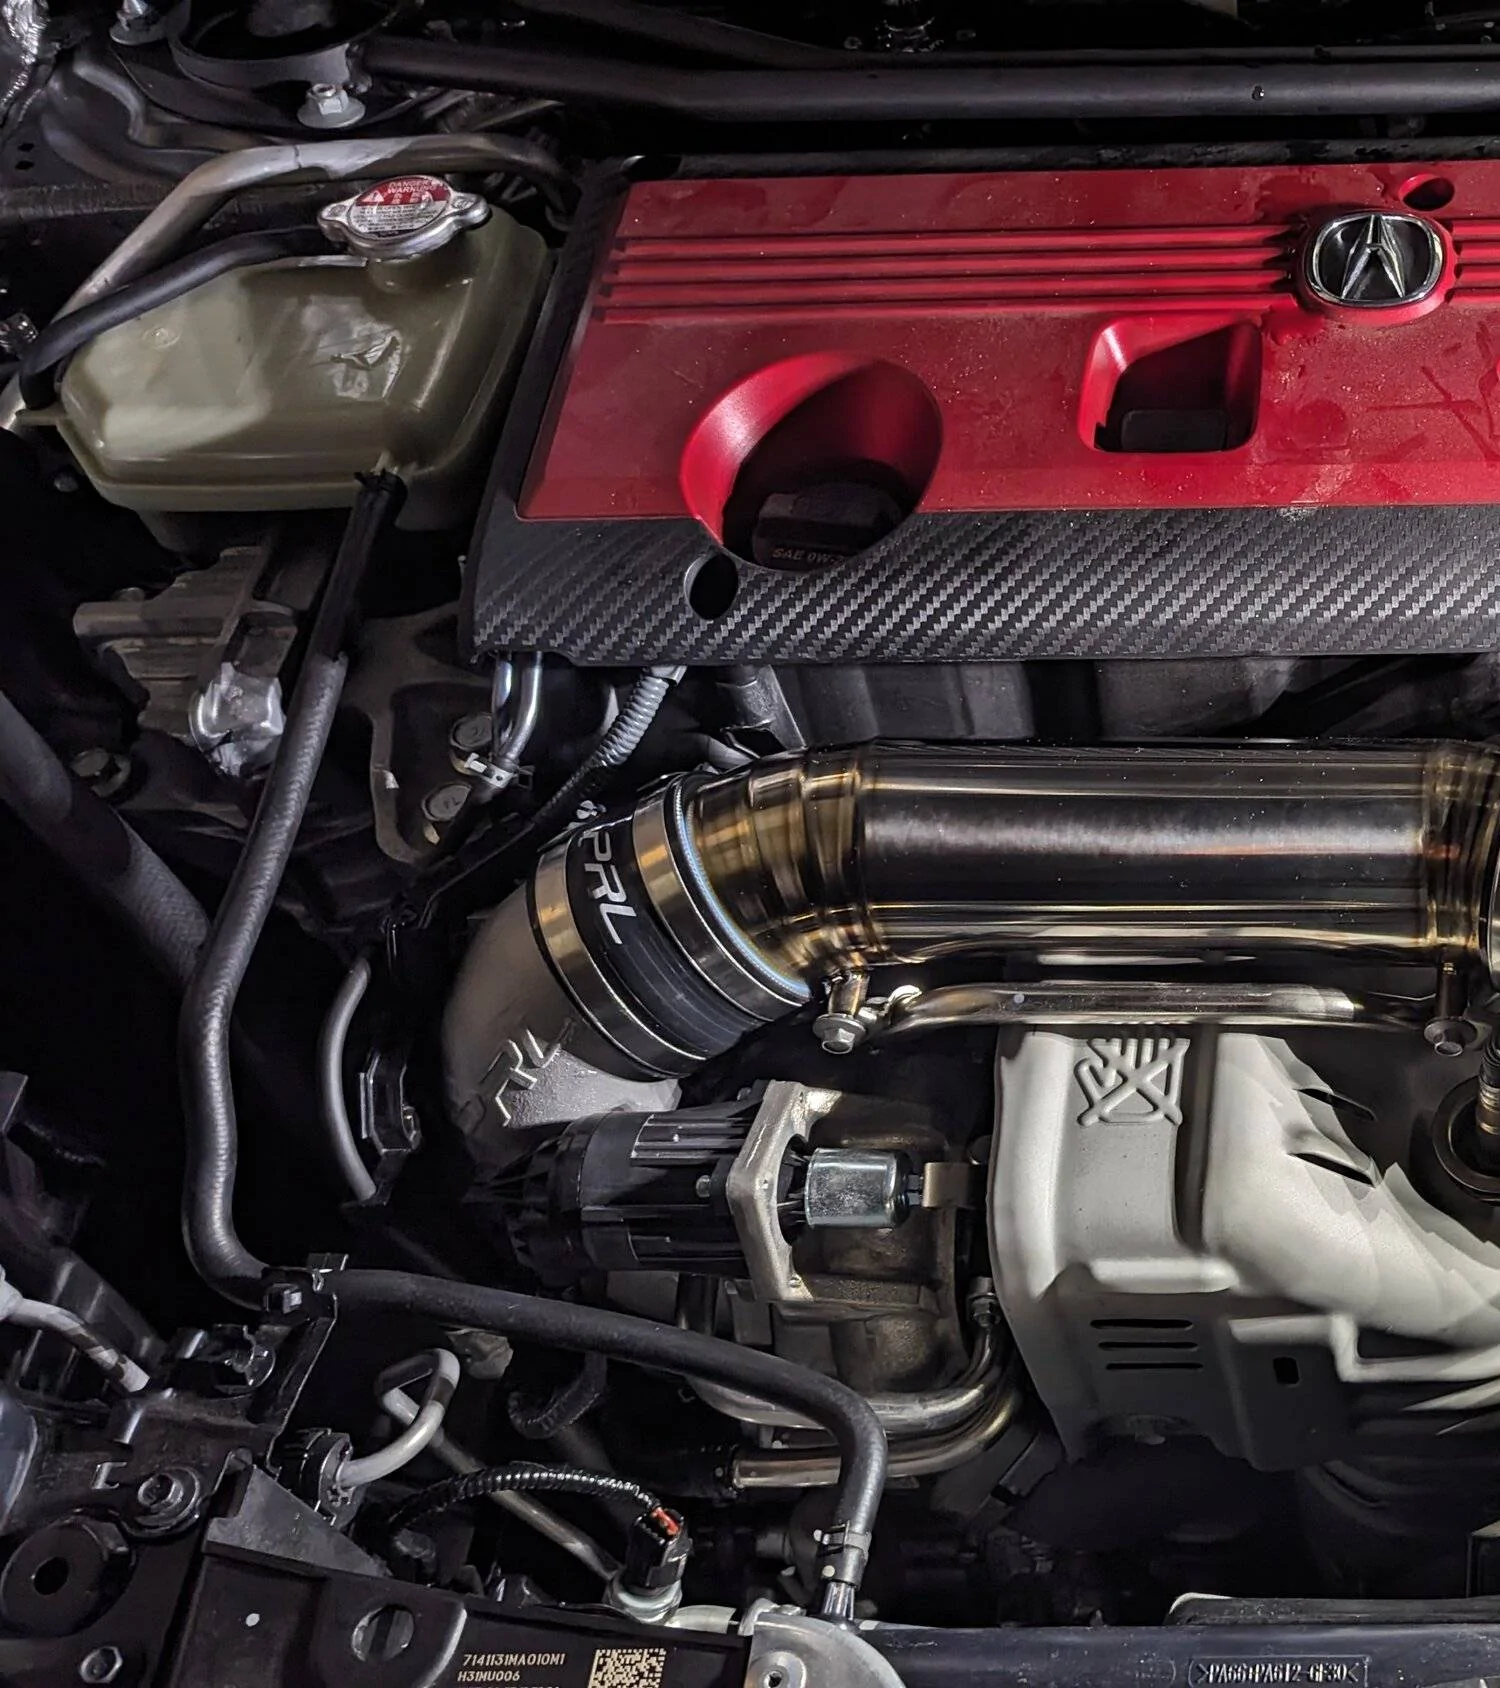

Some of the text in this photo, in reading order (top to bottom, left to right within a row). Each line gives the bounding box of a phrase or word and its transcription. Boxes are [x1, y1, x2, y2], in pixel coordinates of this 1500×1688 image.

[772, 548, 805, 560] SAE
[578, 830, 637, 945] PRL
[457, 1671, 520, 1682] H31MU006
